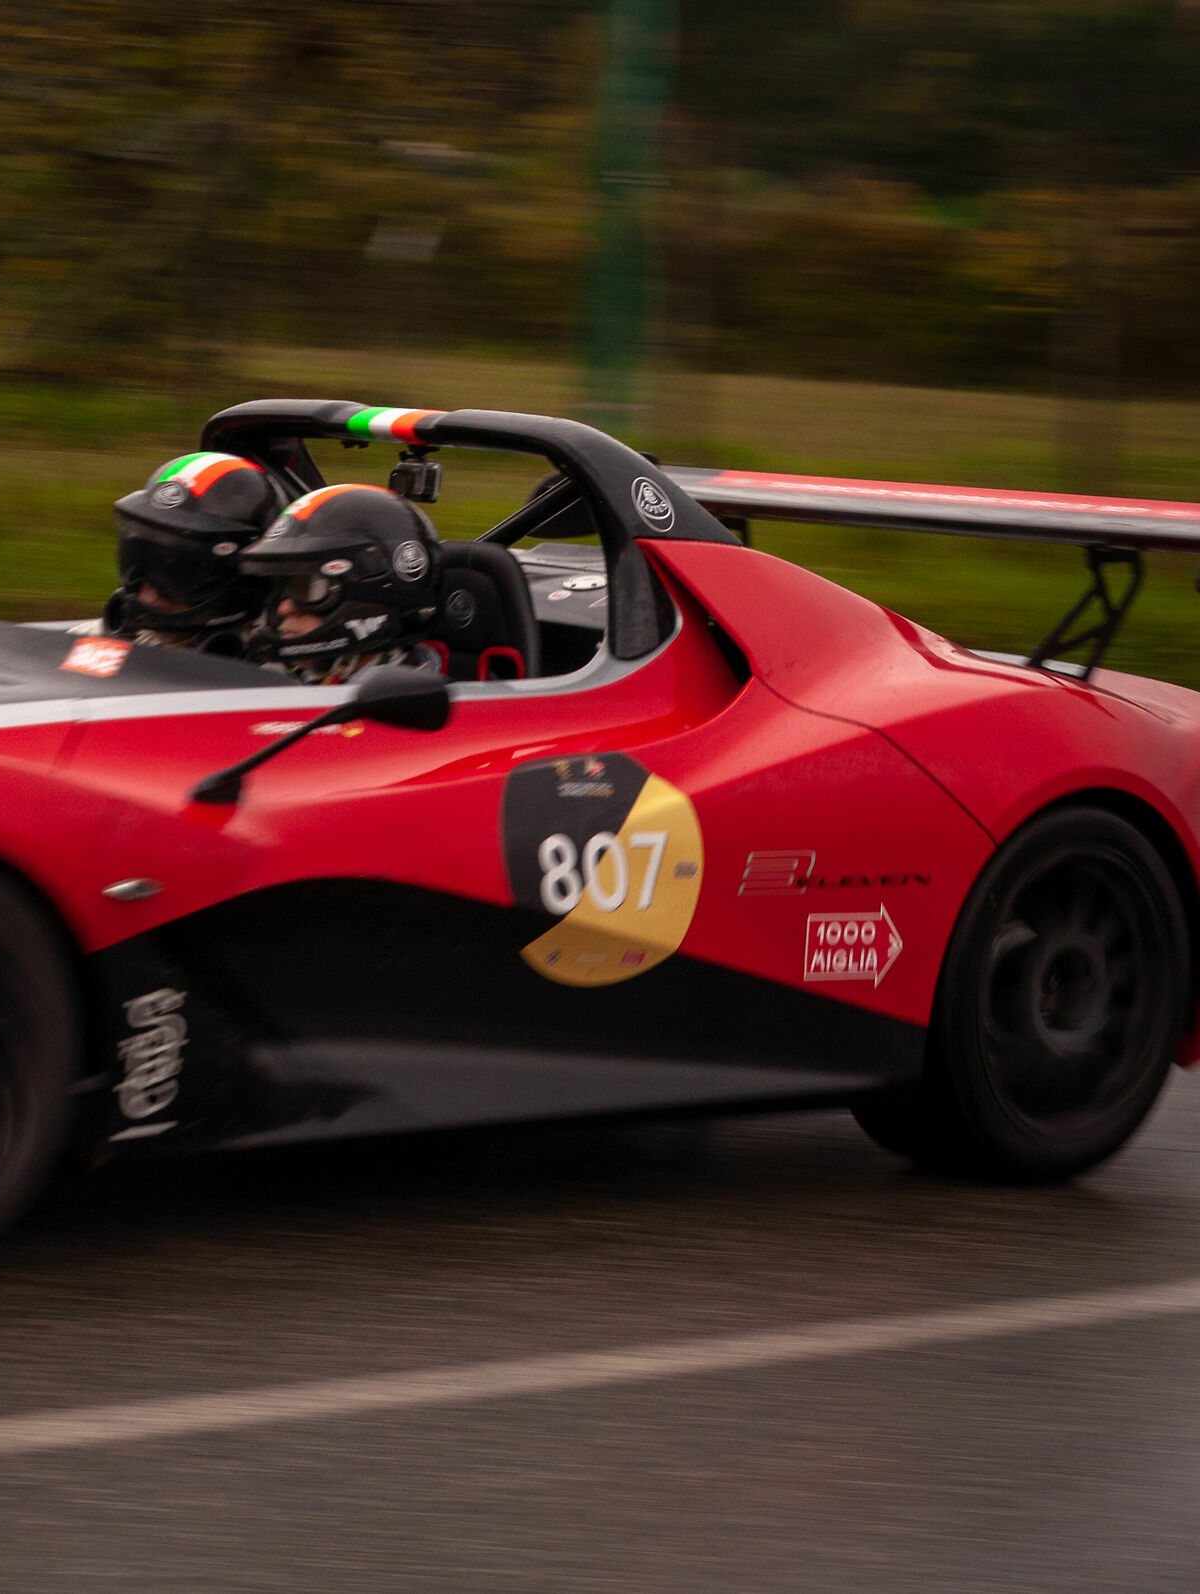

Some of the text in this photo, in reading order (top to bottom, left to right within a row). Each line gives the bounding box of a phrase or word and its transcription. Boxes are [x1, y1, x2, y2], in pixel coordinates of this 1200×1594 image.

[538, 831, 668, 915] 807
[816, 921, 877, 946] 1000
[809, 948, 878, 974] MIGLIA
